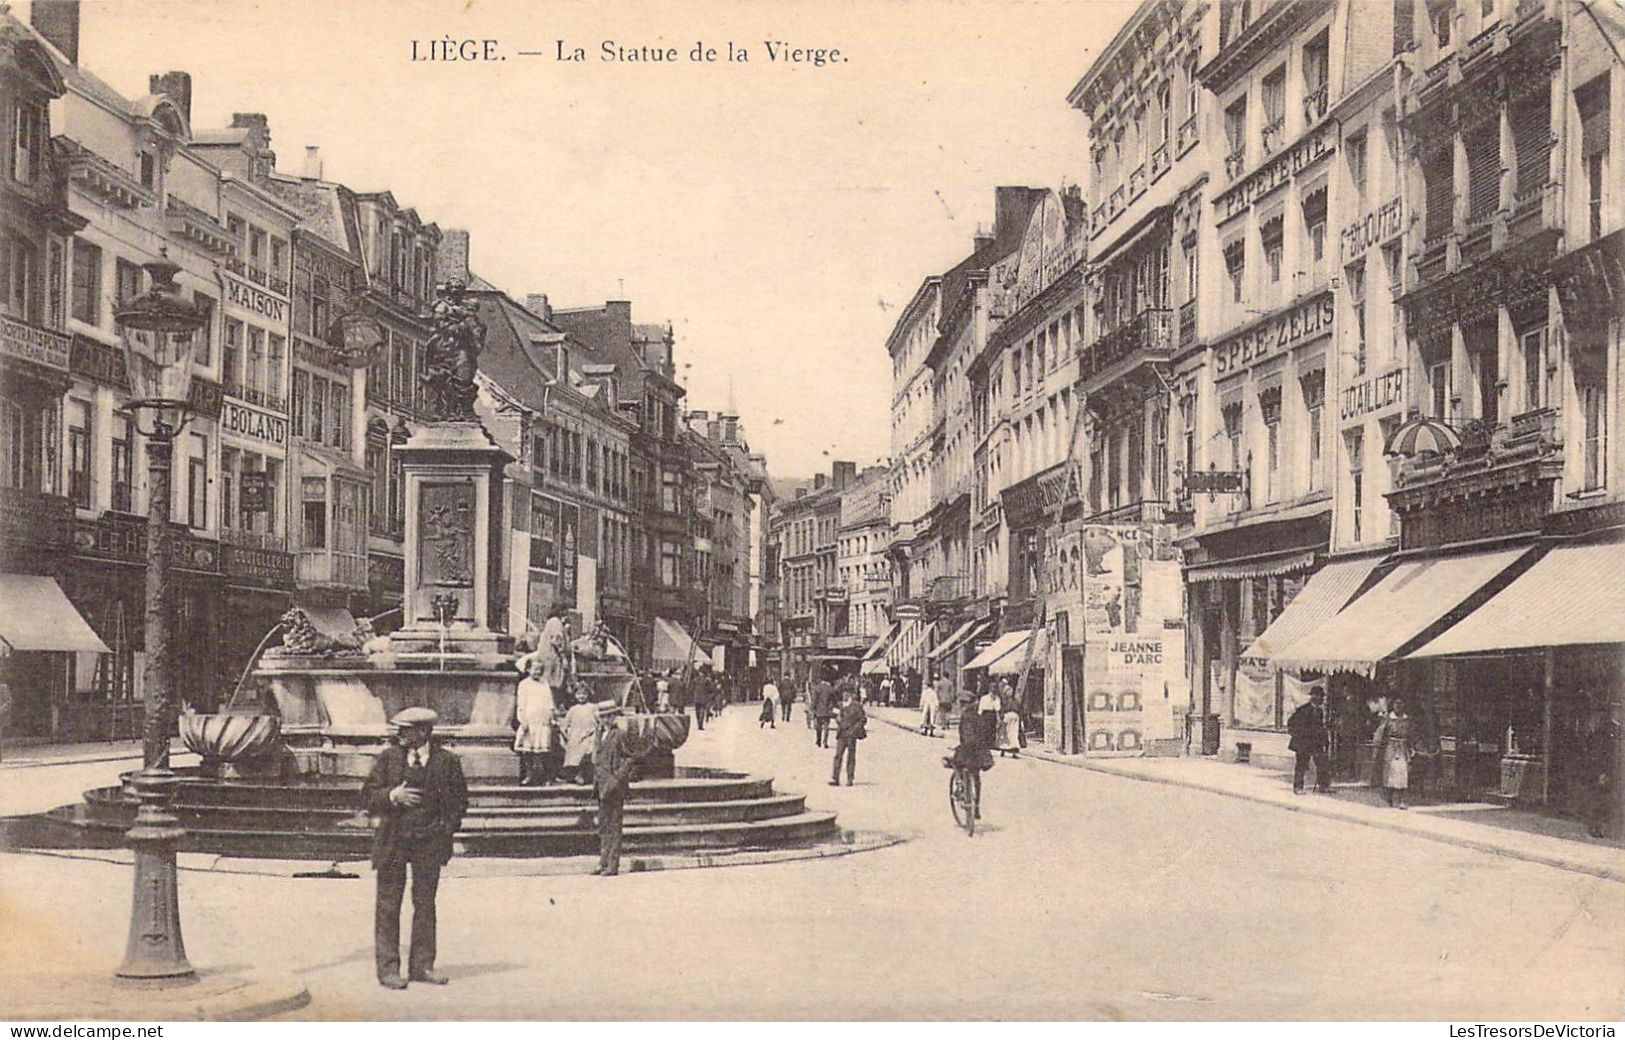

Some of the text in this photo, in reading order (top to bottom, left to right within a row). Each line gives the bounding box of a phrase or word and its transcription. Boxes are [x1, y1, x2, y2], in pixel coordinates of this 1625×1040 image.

[1226, 136, 1325, 216] PAPETERIE
[228, 281, 283, 321] MAISON
[1341, 368, 1403, 420] JOAILLIER
[231, 407, 284, 443] BOLAND
[1110, 641, 1163, 653] JEANNE
[1124, 653, 1163, 665] D'ARC
